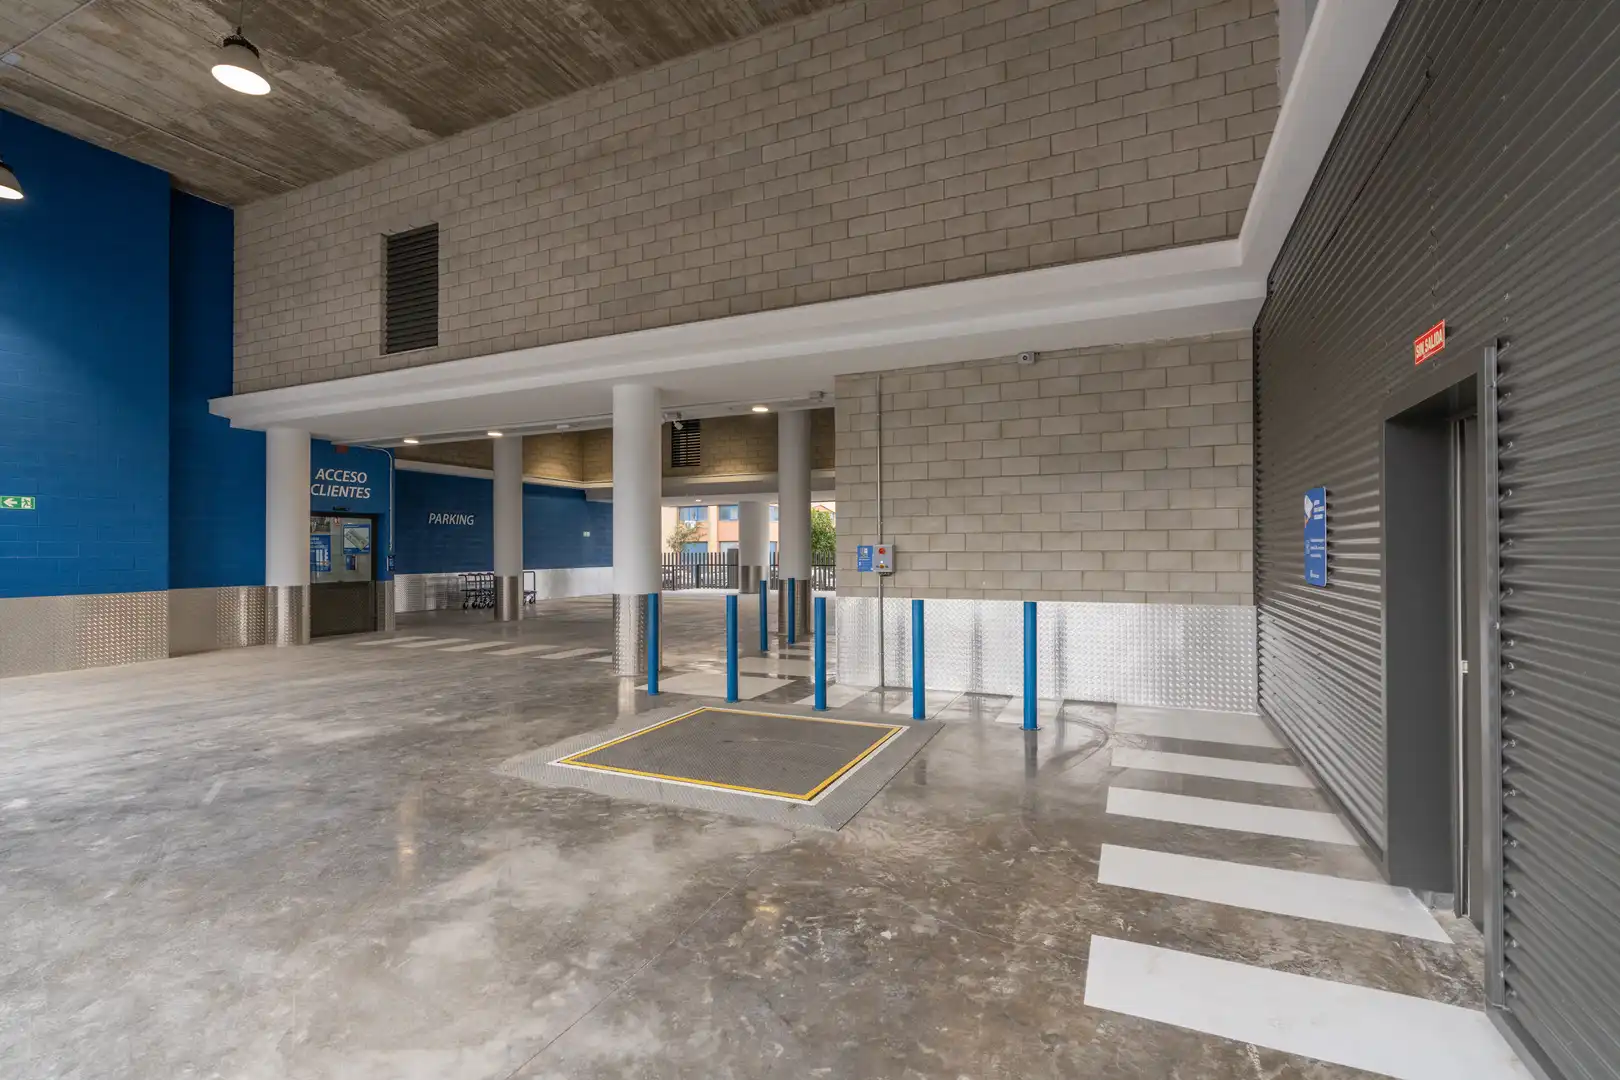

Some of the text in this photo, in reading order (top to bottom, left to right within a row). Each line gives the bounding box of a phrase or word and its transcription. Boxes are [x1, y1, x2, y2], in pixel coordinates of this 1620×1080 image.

[1424, 328, 1443, 353] SALIDA
[315, 468, 368, 484] ACCESO
[310, 483, 371, 499] CLIENTES
[428, 512, 474, 526] PARKING
